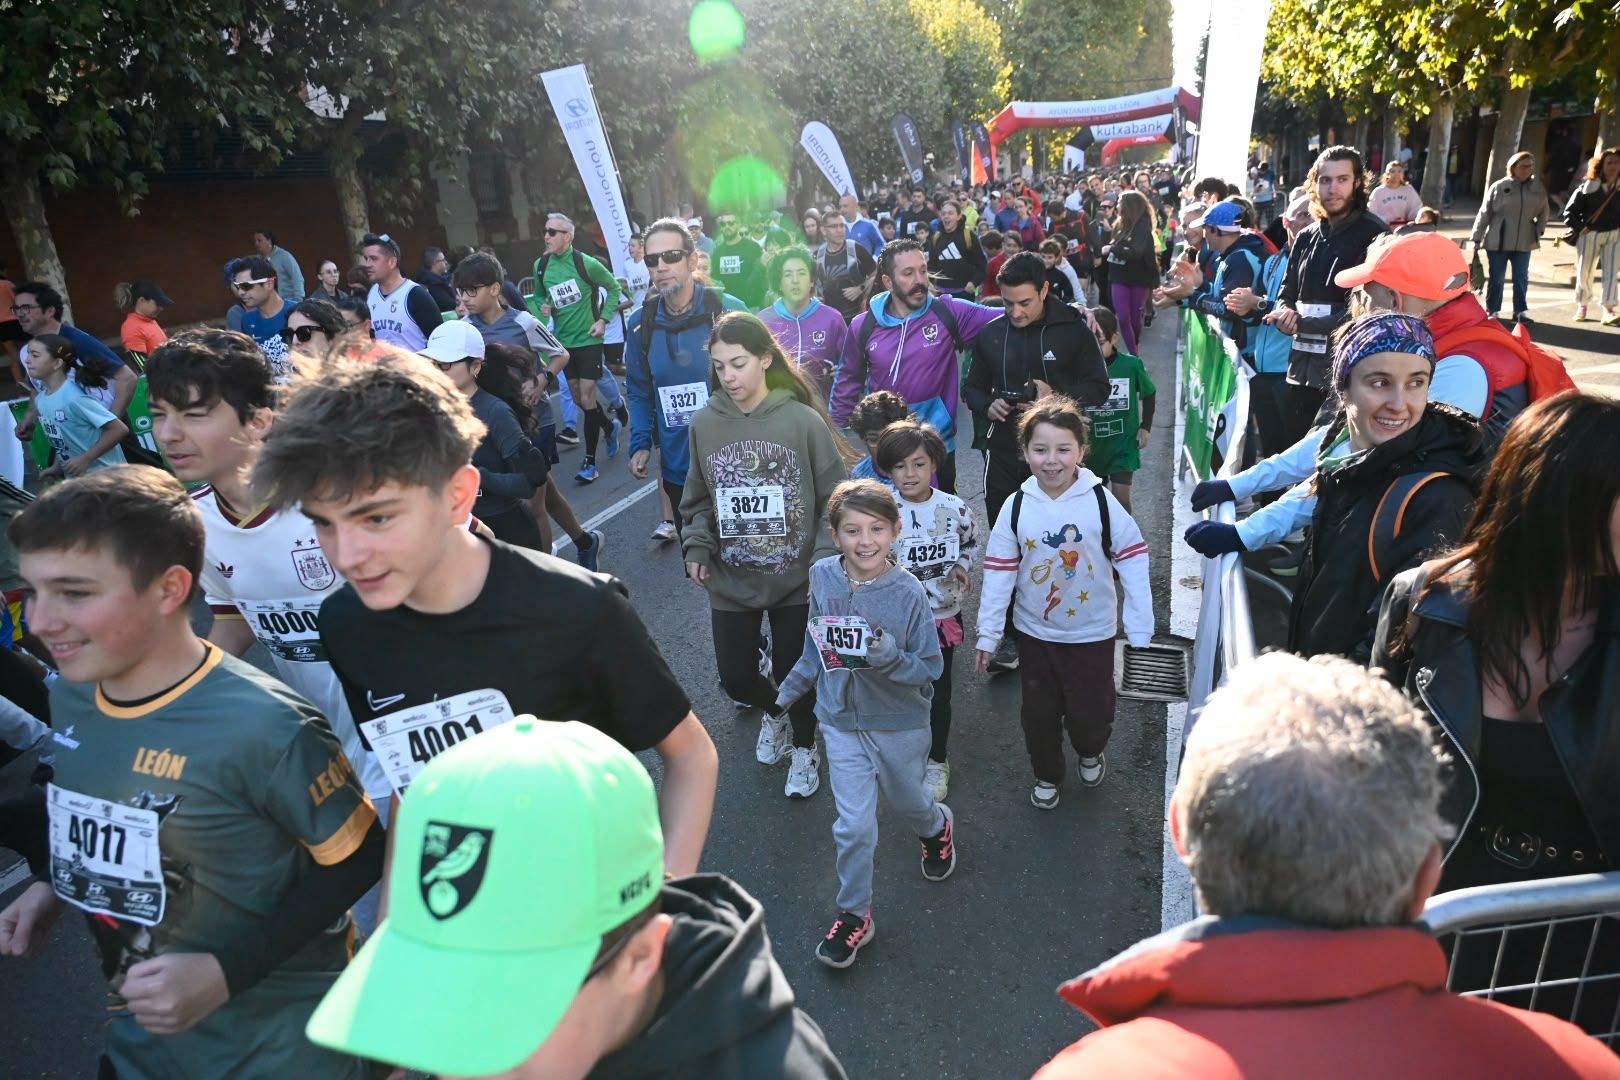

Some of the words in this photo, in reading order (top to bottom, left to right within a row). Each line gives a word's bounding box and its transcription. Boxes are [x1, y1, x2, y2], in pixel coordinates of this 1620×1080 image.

[1048, 104, 1106, 116] AYUNTAMIENTO
[1108, 103, 1118, 112] DE
[1096, 121, 1164, 136] kutxabank
[556, 285, 573, 297] 4614
[372, 319, 403, 334] EUTA
[669, 391, 697, 409] 3327
[731, 495, 769, 514] 3827
[907, 542, 947, 563] 4325
[257, 610, 320, 635] 4000
[826, 626, 863, 650] 4357
[407, 713, 484, 764] 4001
[132, 747, 187, 780] LEÓN
[68, 813, 127, 865] 4017
